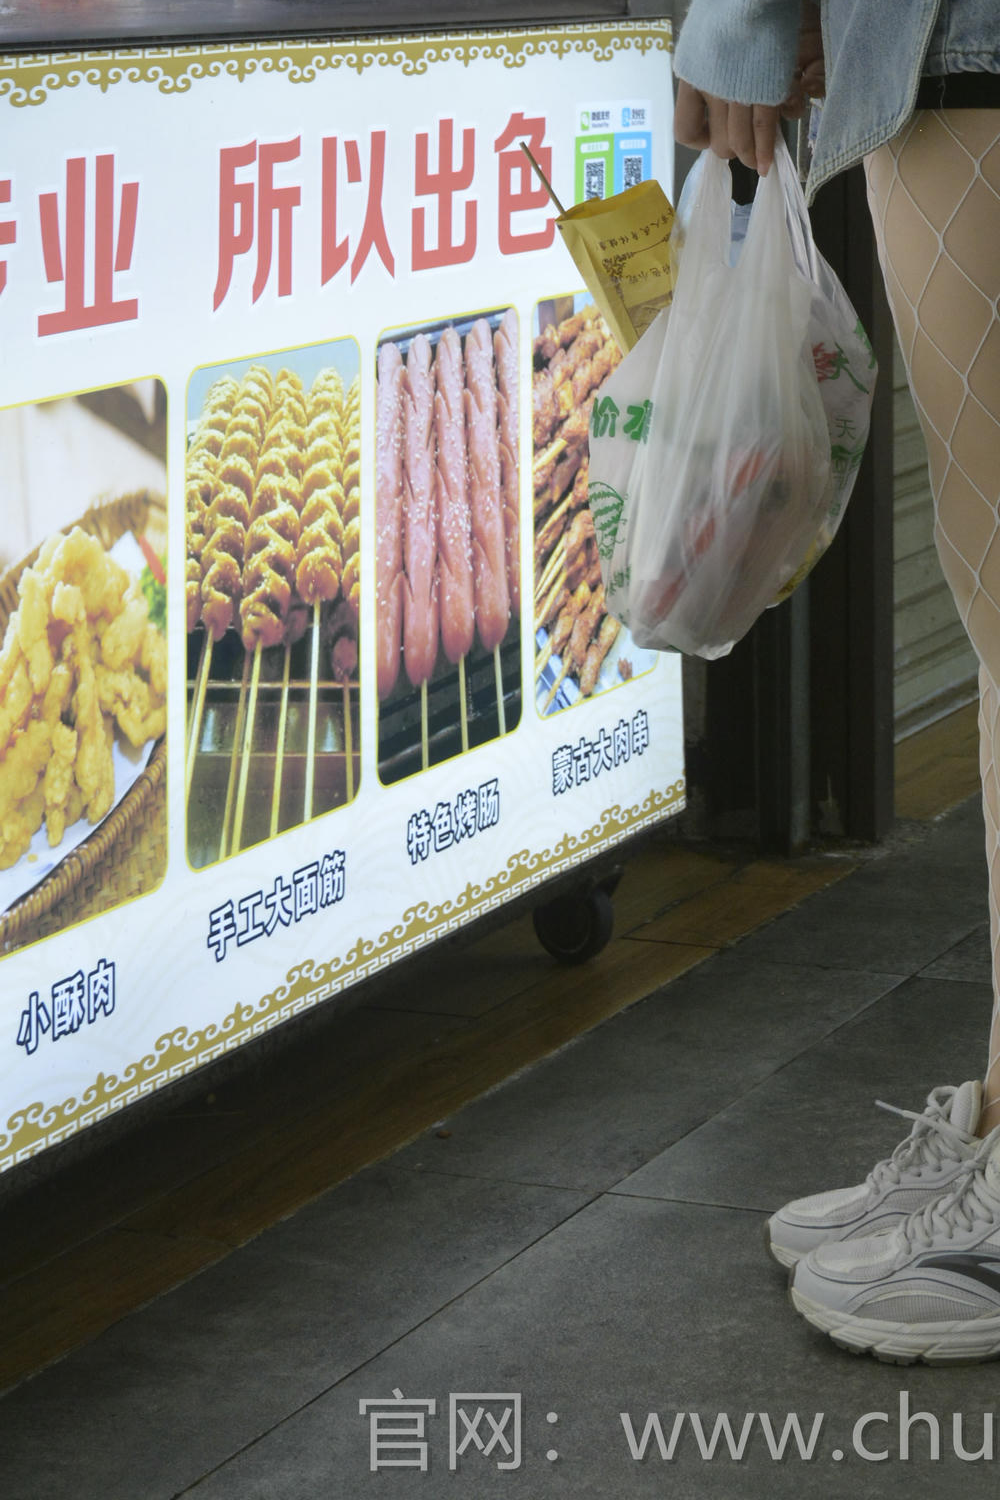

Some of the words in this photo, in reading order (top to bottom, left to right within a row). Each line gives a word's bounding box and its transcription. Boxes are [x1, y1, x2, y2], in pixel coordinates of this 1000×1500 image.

[213, 112, 556, 313] 所以出色
[552, 710, 650, 796] 蒙古大肉串
[406, 779, 500, 865] 特色烤肠
[207, 851, 346, 962] 手工大面筋
[17, 959, 116, 1054] 小酥肉
